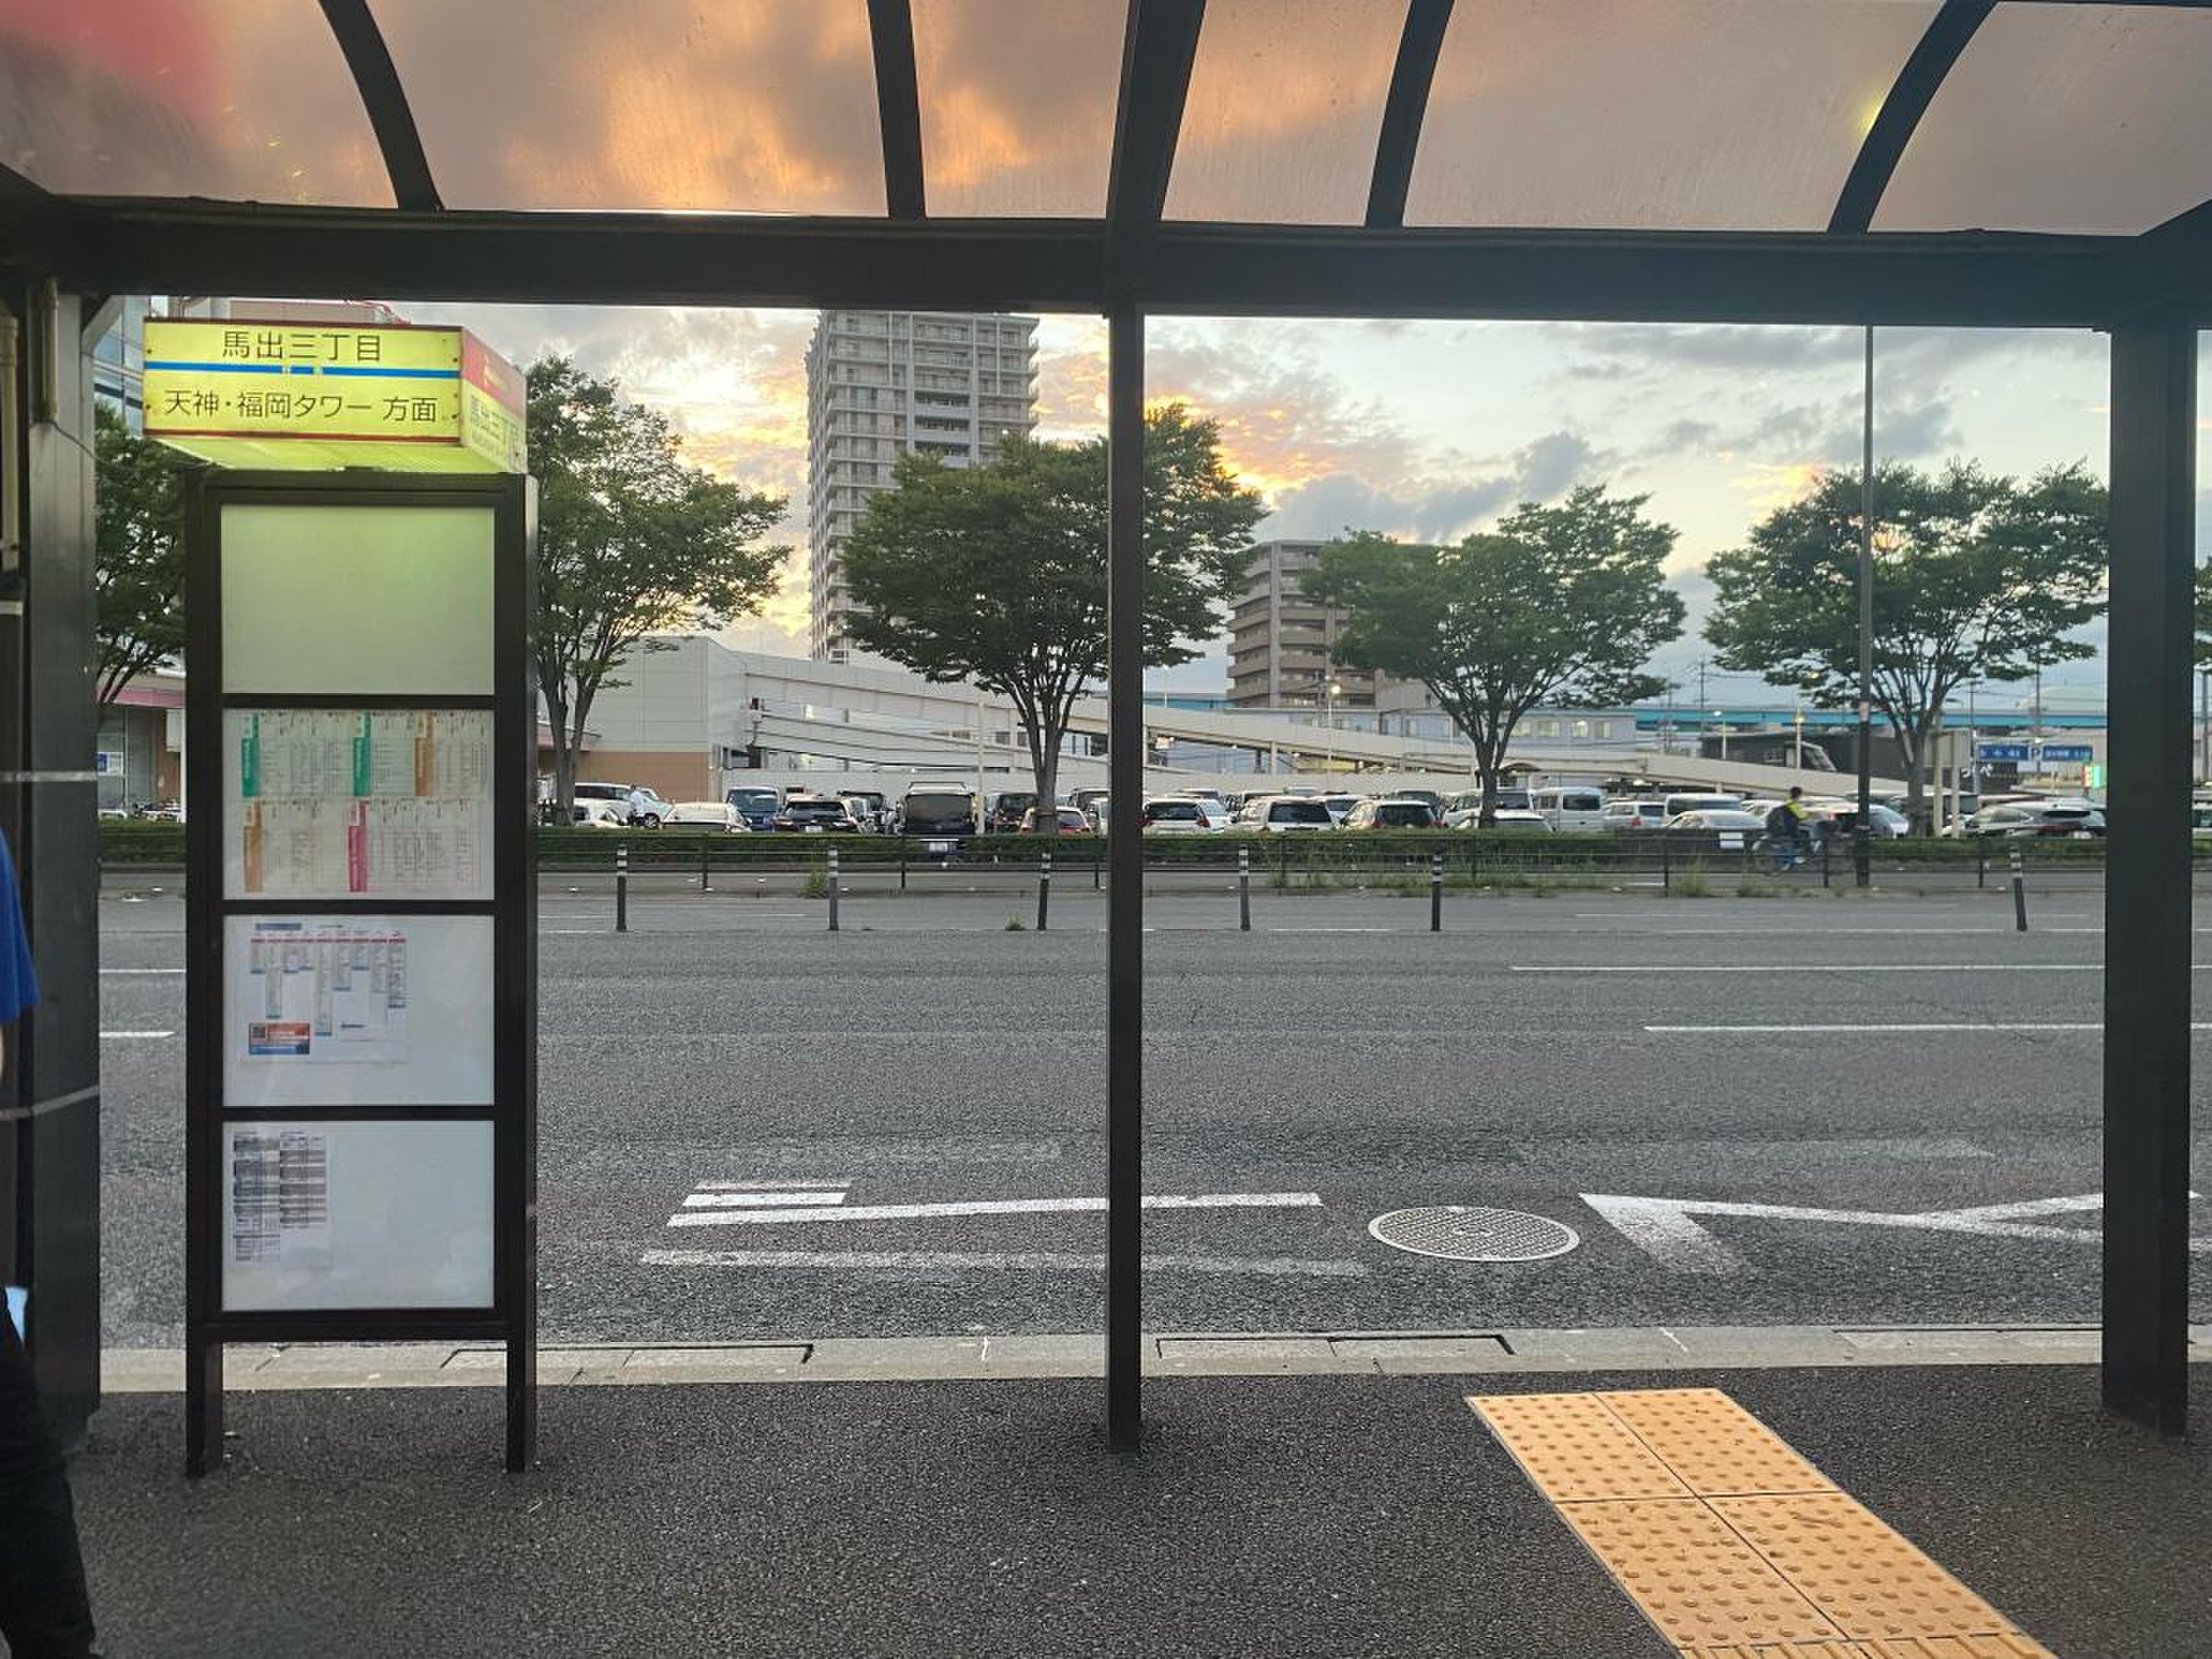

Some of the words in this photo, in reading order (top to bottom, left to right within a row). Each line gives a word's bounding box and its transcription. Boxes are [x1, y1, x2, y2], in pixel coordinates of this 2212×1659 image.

[222, 330, 380, 361] 馬出三丁目
[164, 389, 371, 418] 天神・福岡タワー
[382, 394, 438, 422] 方面
